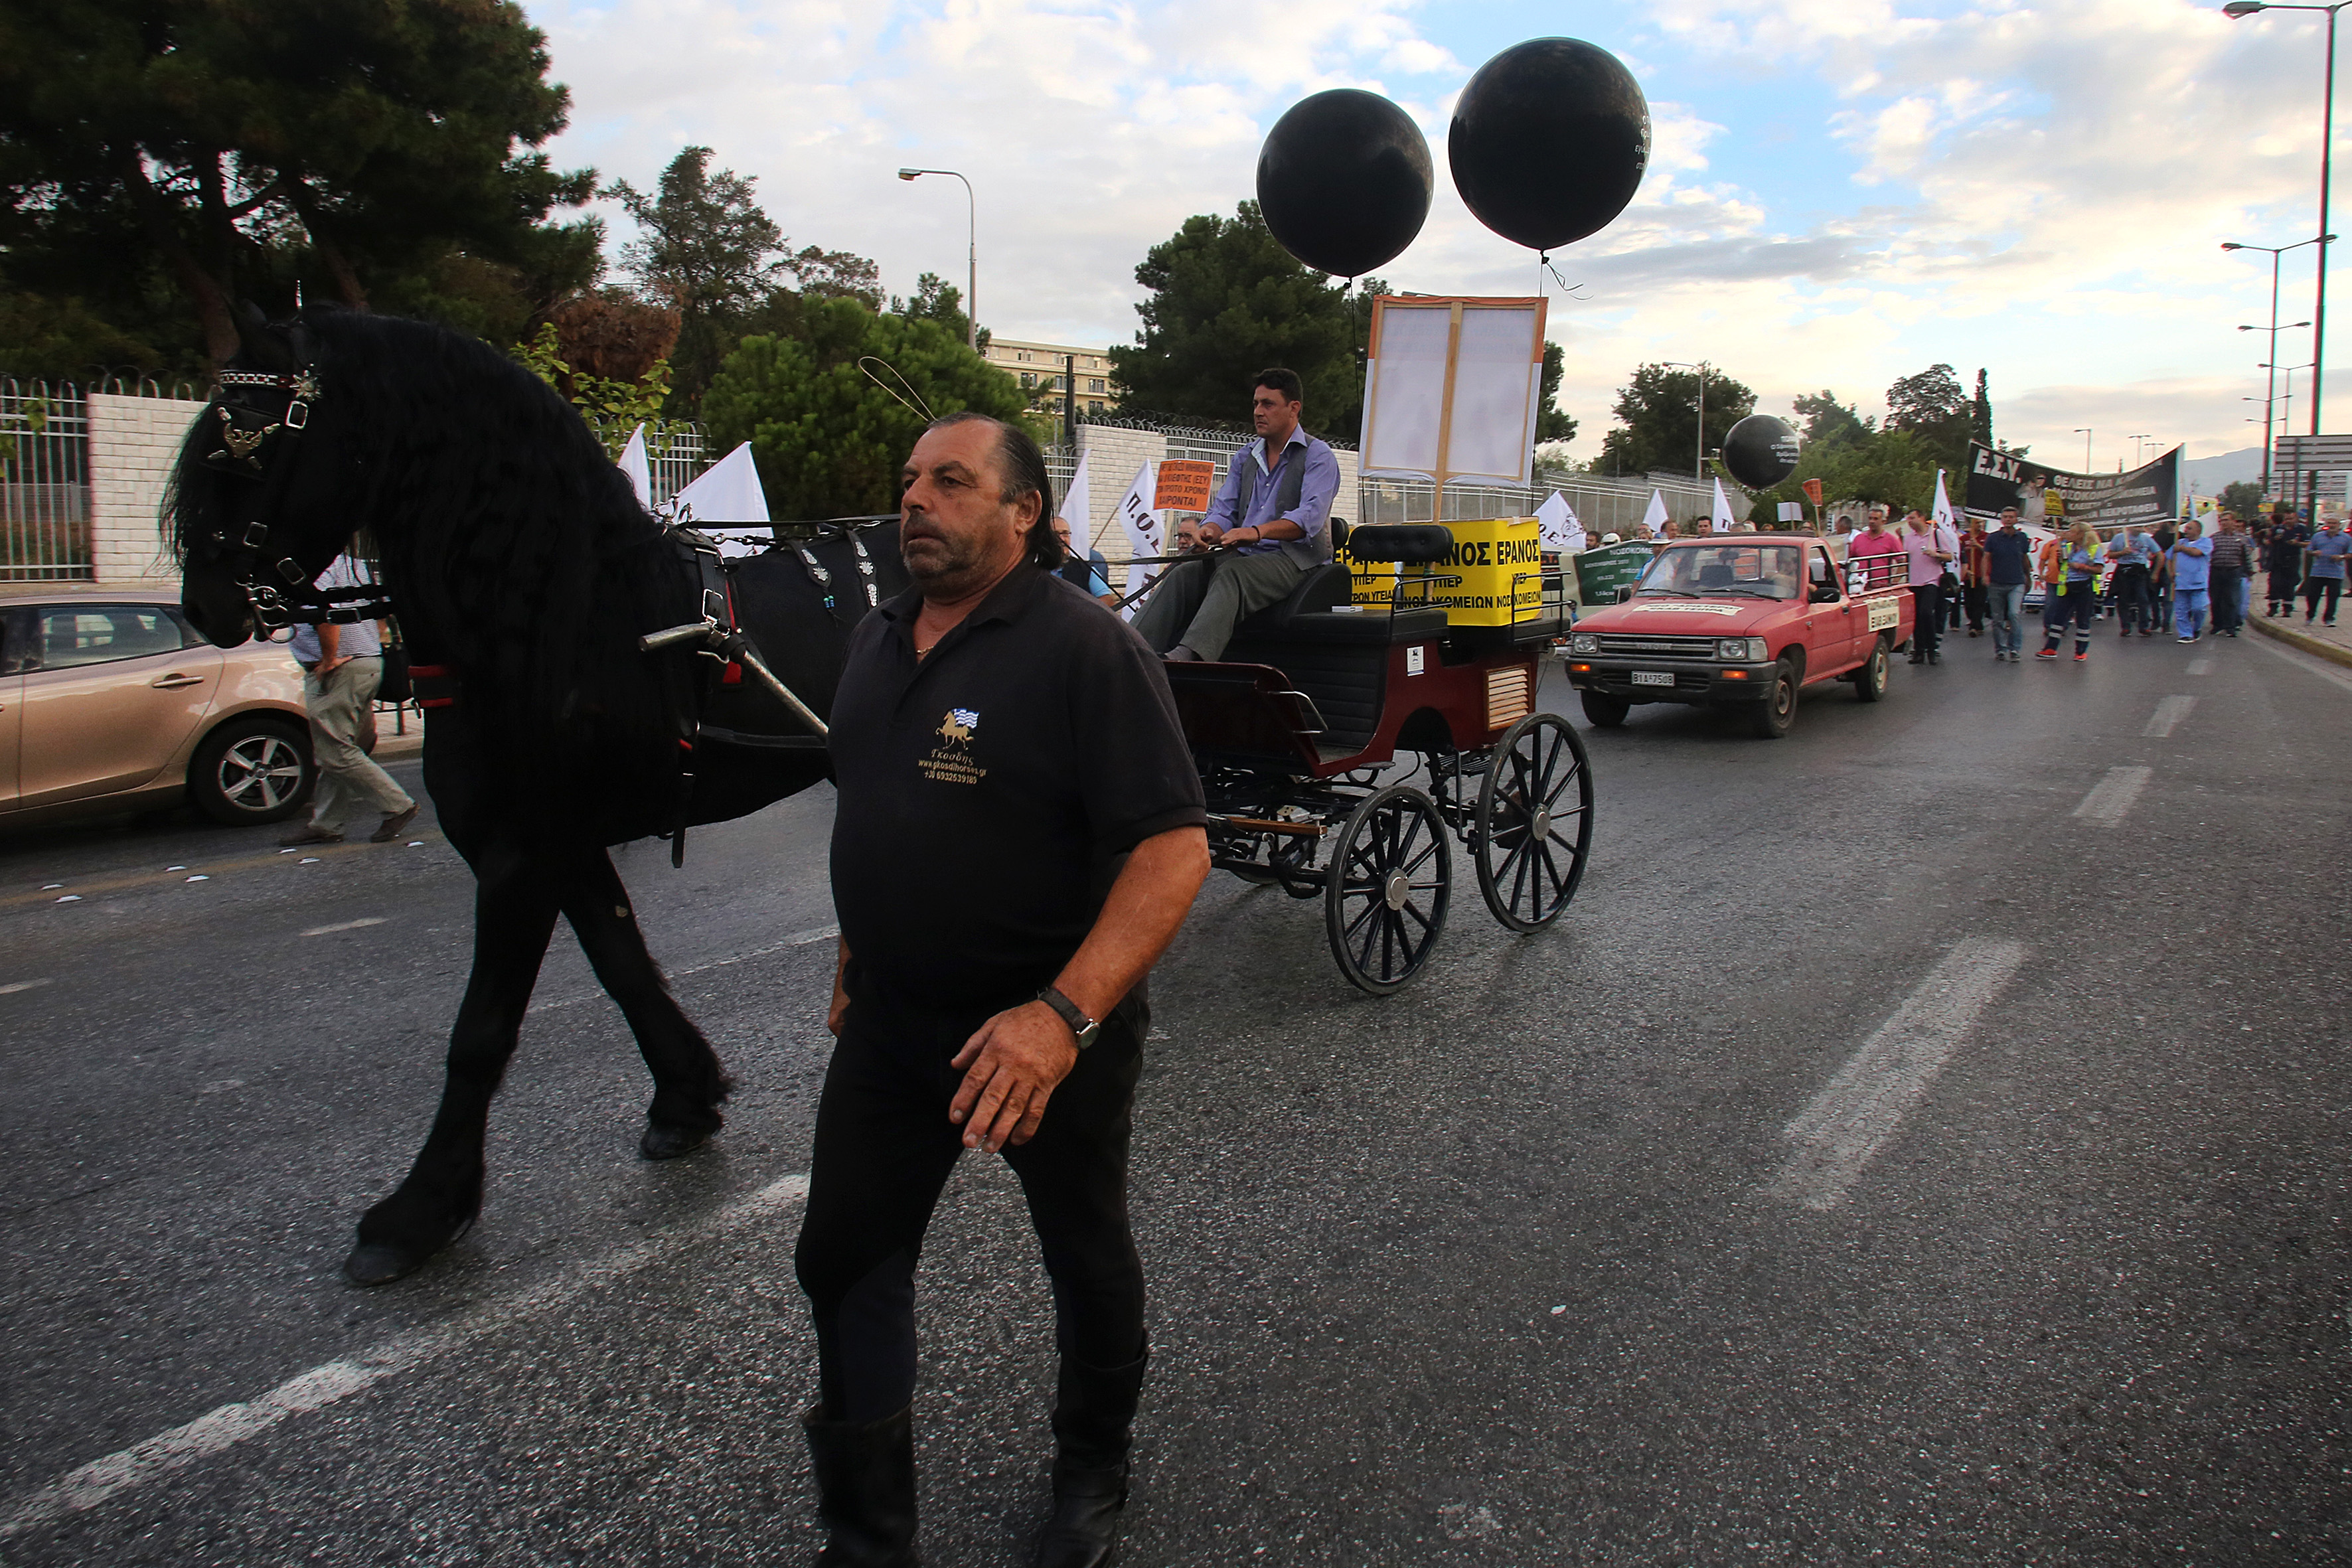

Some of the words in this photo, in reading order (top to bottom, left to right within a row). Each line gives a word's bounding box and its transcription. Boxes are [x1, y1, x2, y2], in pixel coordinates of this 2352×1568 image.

[1973, 448, 2022, 484] Ε.Σ.Υ.
[1497, 539, 1539, 565] ΕΡΑΝΟΣ
[1404, 595, 1493, 609] ΝΟΣΚΟΜΕΙΩΝ
[1497, 590, 1541, 608] ΝΟΣΚΟΜΕΙΩΝ
